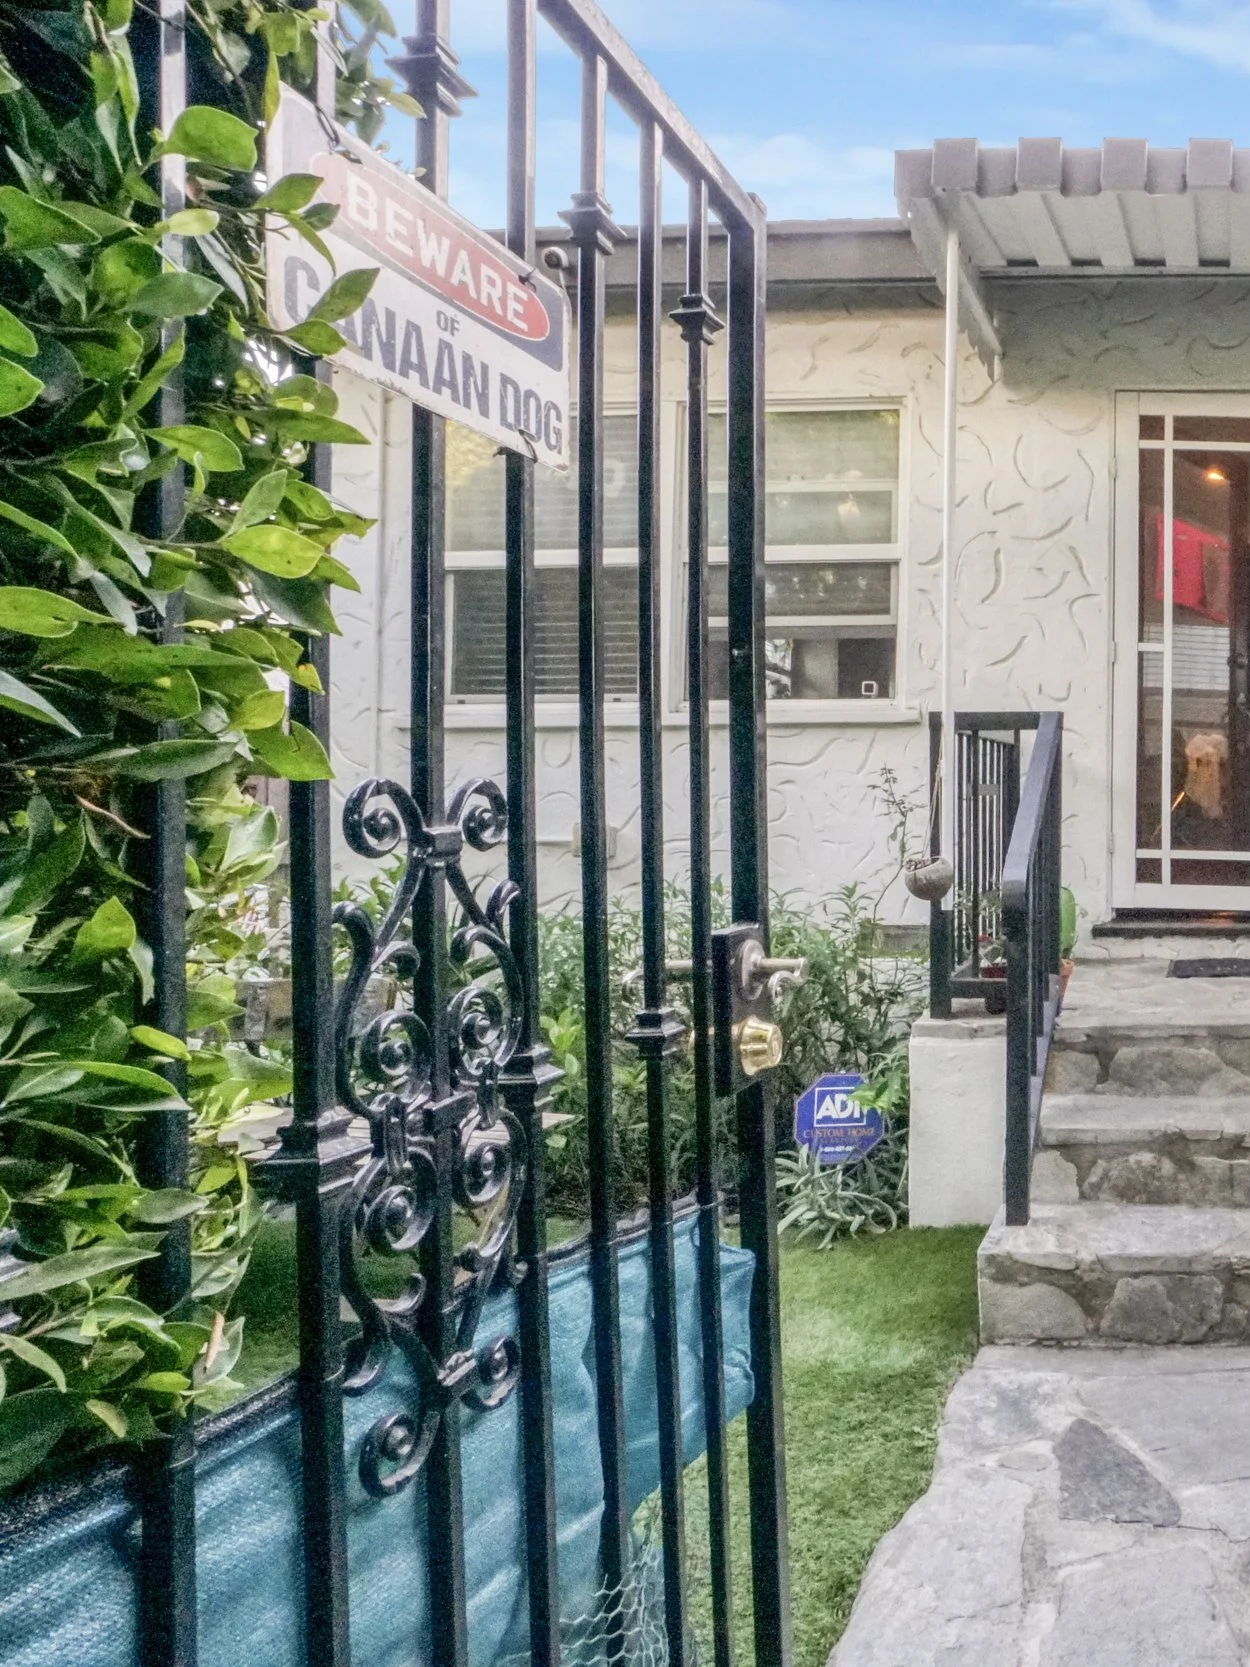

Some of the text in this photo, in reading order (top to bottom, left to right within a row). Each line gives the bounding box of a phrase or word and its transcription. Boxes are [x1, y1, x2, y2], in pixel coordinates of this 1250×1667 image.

[347, 171, 528, 332] BEWARE
[435, 309, 461, 338] OF
[499, 372, 563, 456] DOG
